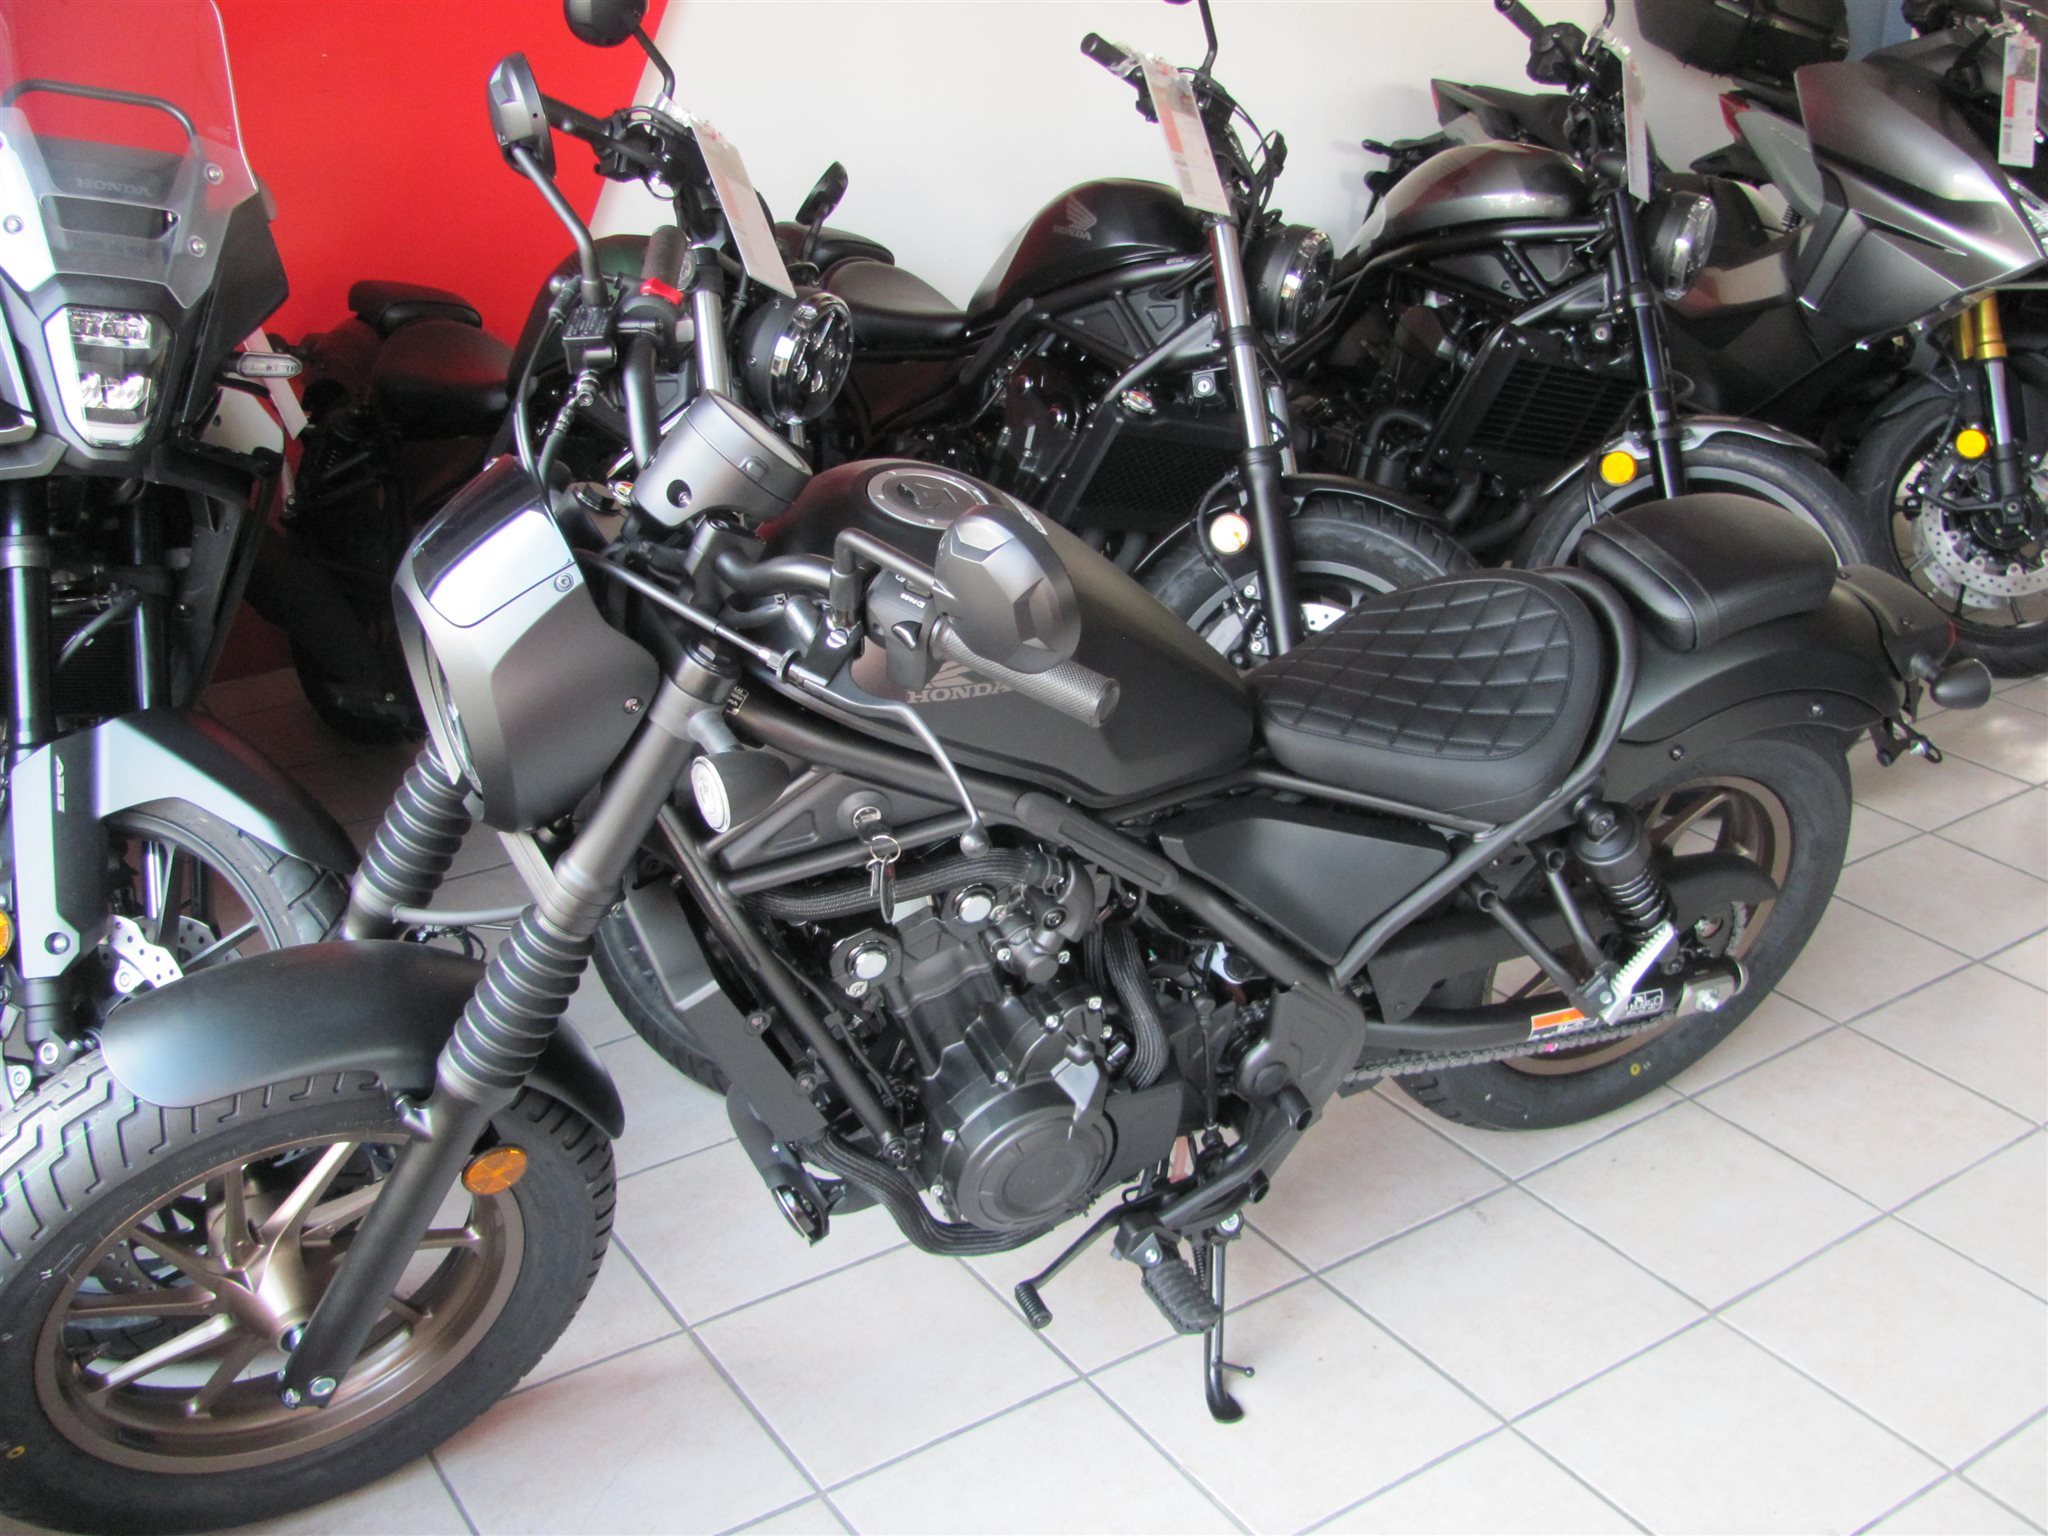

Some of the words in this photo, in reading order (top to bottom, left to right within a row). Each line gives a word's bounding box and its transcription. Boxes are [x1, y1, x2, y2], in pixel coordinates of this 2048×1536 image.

[75, 178, 152, 197] HONDA
[1053, 224, 1092, 241] HONDA
[906, 681, 1013, 704] HONDA
